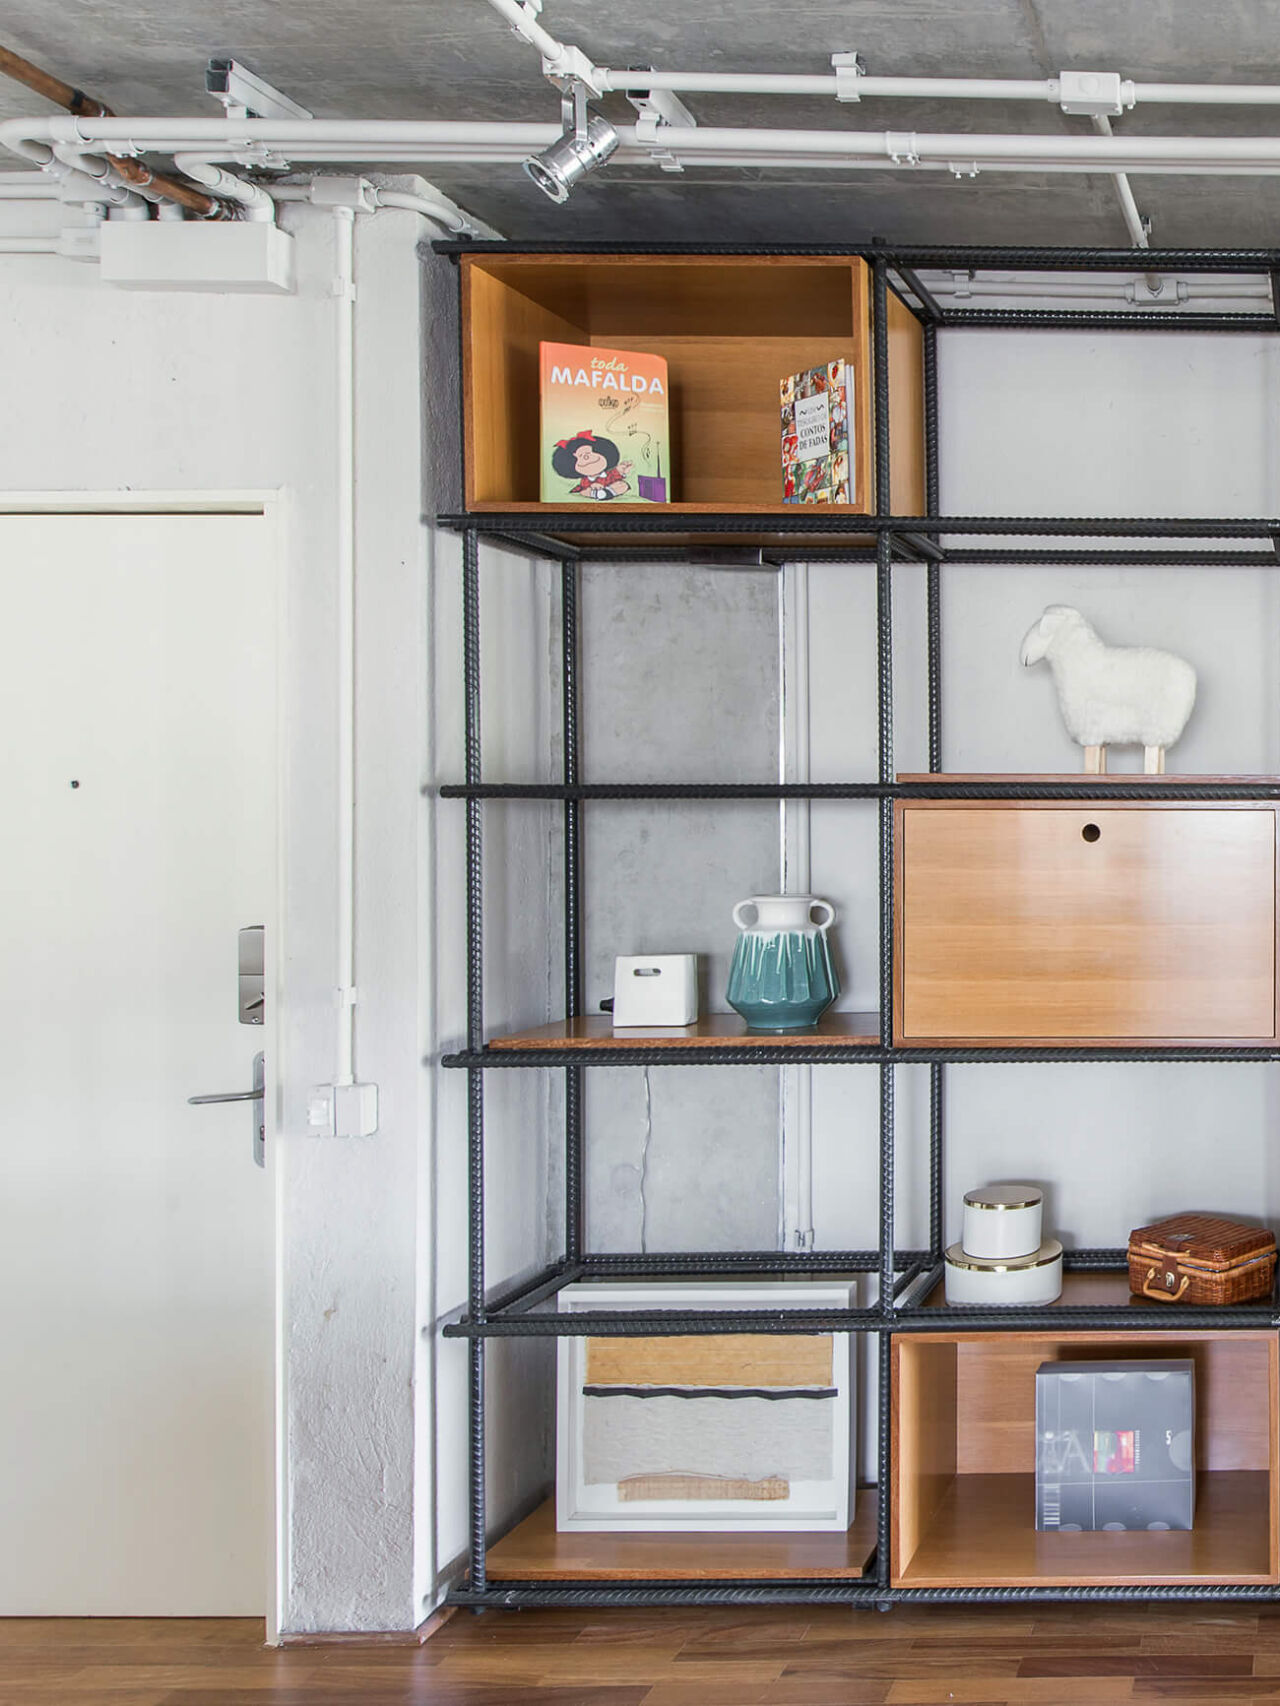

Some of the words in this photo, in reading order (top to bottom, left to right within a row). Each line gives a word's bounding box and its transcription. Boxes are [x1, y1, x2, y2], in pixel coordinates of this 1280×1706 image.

[590, 356, 629, 372] toda
[550, 365, 665, 395] MAFALDA
[800, 425, 826, 439] CONTOS
[799, 440, 808, 450] DE
[809, 435, 828, 448] FADAS
